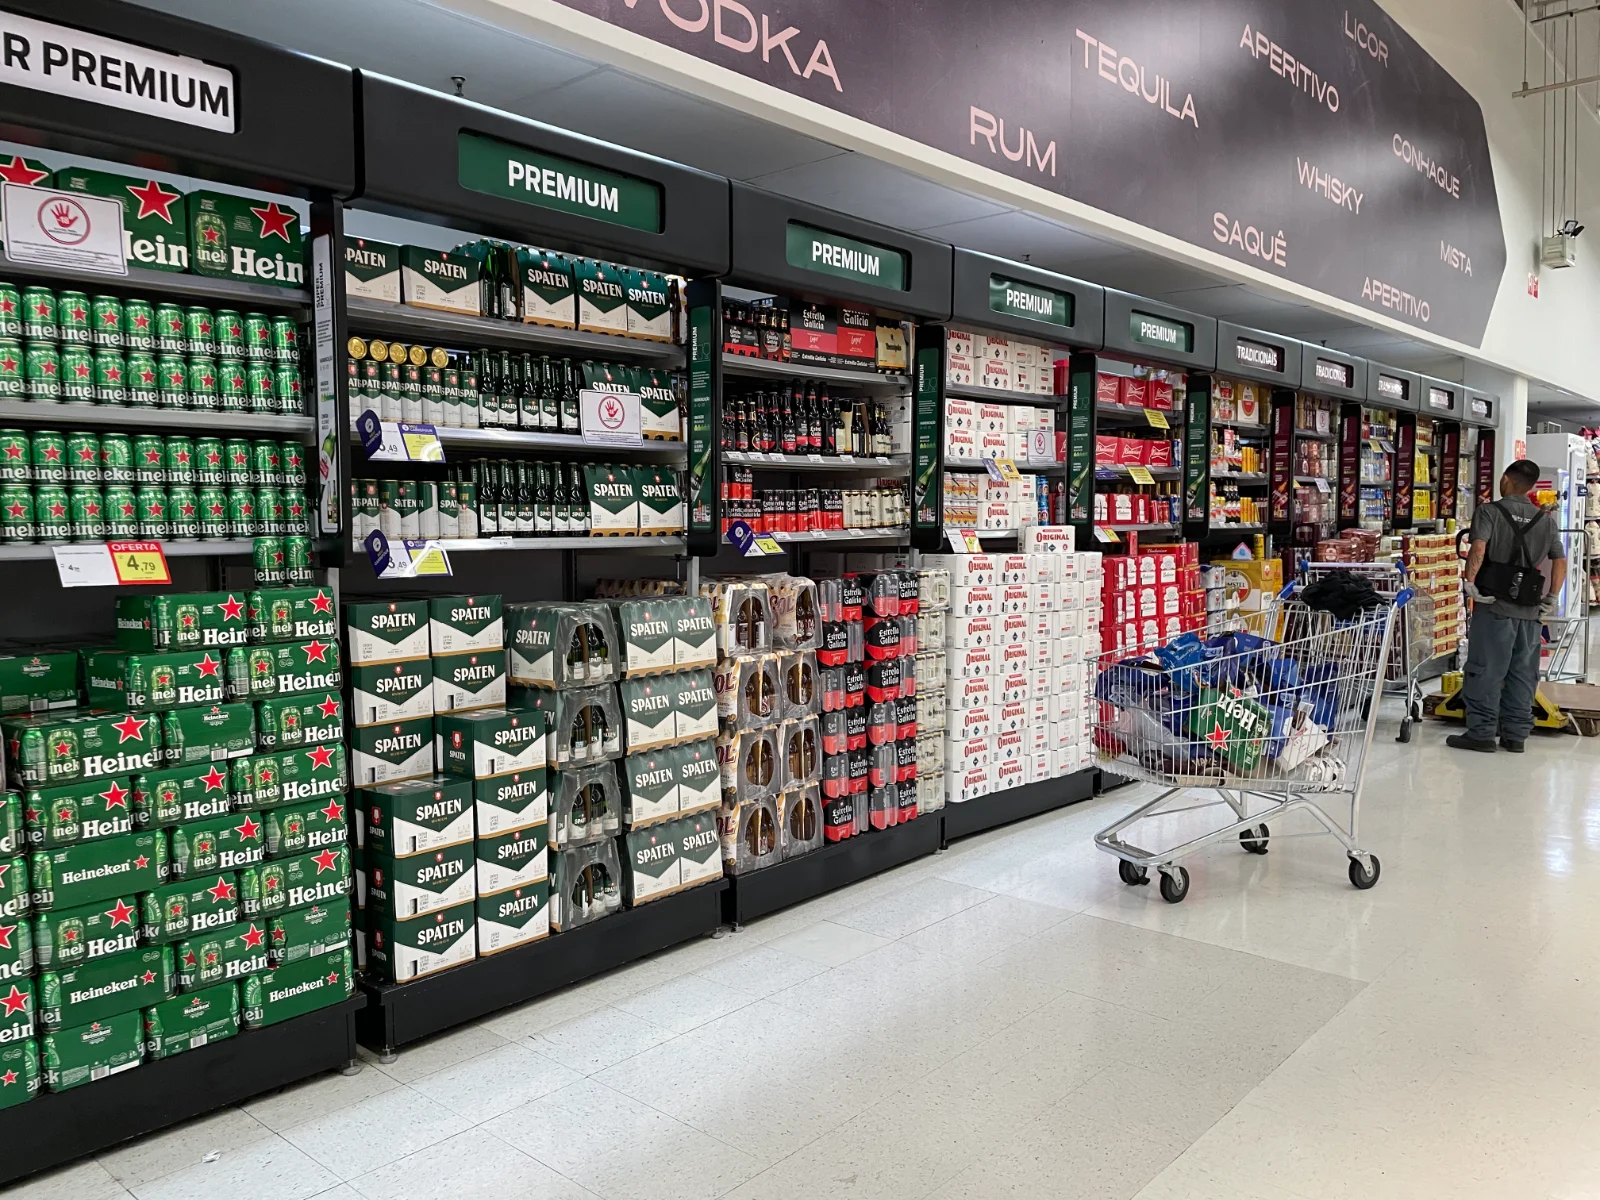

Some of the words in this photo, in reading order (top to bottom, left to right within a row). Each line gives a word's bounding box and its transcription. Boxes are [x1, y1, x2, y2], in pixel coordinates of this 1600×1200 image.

[623, 0, 844, 93] ODKA
[1344, 10, 1389, 68] LICOR
[1239, 24, 1340, 113] APERITIVO
[43, 41, 230, 118] PREMIUM
[1075, 28, 1199, 129] TEQUILA
[970, 105, 1057, 178] RUM
[1392, 133, 1461, 200] CONHAQUE
[508, 159, 620, 213] PREMIUM
[1297, 156, 1364, 215] WHISKY
[1213, 212, 1288, 268] SAQUÊ
[231, 245, 303, 284] Hein
[812, 240, 880, 277] PREMIUM
[1439, 240, 1473, 278] MISTA
[424, 259, 468, 281] SPATEN
[528, 268, 570, 289] SPATEN
[583, 278, 623, 299] SPATEN
[628, 287, 667, 306] SPATEN
[1006, 288, 1053, 316] PREMIUM
[1361, 276, 1431, 323] APERITIVO
[803, 310, 825, 321] Estrella
[843, 312, 869, 327] Galicia
[804, 319, 824, 330] Galicia
[1141, 321, 1177, 344] PREMIUM
[947, 330, 971, 342] ORIGINAL
[1236, 344, 1278, 367] TRADICIONAIS
[985, 362, 1009, 377] ORIGINAL
[641, 386, 677, 402] SPATEN
[947, 402, 973, 416] ORIGINAL
[980, 408, 1005, 421] ORIGINAL
[950, 433, 973, 446] ORIGINAL
[983, 435, 1006, 448] ORIGINAL
[594, 483, 634, 497] SPATEN
[642, 483, 679, 497] SPATEN
[988, 479, 1010, 490] ORIGINAL
[987, 506, 1009, 519] ORIGINAL
[1036, 532, 1070, 543] ORIGINAL
[111, 543, 159, 551] OFERTA
[968, 560, 993, 573] ORIGINAL
[899, 580, 917, 591] Estrella
[900, 588, 917, 599] Galicia
[968, 592, 993, 604] ORIGINAL
[1004, 590, 1028, 602] ORIGINAL
[371, 613, 416, 629] SPATEN
[451, 606, 491, 623] SPATEN
[630, 620, 669, 637] SPATEN
[677, 617, 713, 634] SPATEN
[879, 627, 899, 638] Estrella
[968, 622, 992, 635] ORIGINAL
[1004, 619, 1027, 632] ORIGINAL
[515, 630, 550, 645] SPATEN
[827, 632, 846, 642] Estrella
[828, 639, 847, 650] Galicia
[880, 635, 899, 646] Galicia
[966, 653, 991, 666] ORIGINAL
[1004, 649, 1027, 662] ORIGINAL
[453, 664, 495, 682] SPATEN
[376, 675, 422, 693] SPATEN
[964, 683, 990, 697] ORIGINAL
[1005, 678, 1027, 691] ORIGINAL
[631, 694, 670, 713] SPATEN
[678, 687, 714, 705] SPATEN
[965, 713, 990, 727] ORIGINAL
[1001, 707, 1026, 721] ORIGINAL
[375, 733, 421, 753] SPATEN
[494, 726, 536, 746] SPATEN
[997, 735, 1022, 749] ORIGINAL
[449, 750, 466, 761] SPATEN
[964, 743, 988, 758] ORIGINAL
[682, 758, 717, 778] SPATEN
[998, 764, 1023, 779] ORIGINAL
[635, 768, 673, 788] SPATEN
[964, 773, 988, 789] ORIGINAL
[497, 781, 537, 801] SPATEN
[416, 798, 462, 823] SPATEN
[369, 826, 385, 838] SPATEN
[683, 829, 718, 851] SPATEN
[497, 839, 537, 859] SPATEN
[637, 843, 675, 865] SPATEN
[62, 860, 132, 886] Heineken
[417, 859, 464, 884] SPATEN
[370, 887, 387, 900] SPATEN
[499, 895, 538, 918] SPATEN
[417, 919, 464, 945] SPATEN
[70, 976, 139, 1004] Heineken
[269, 977, 325, 1003] Heineken
